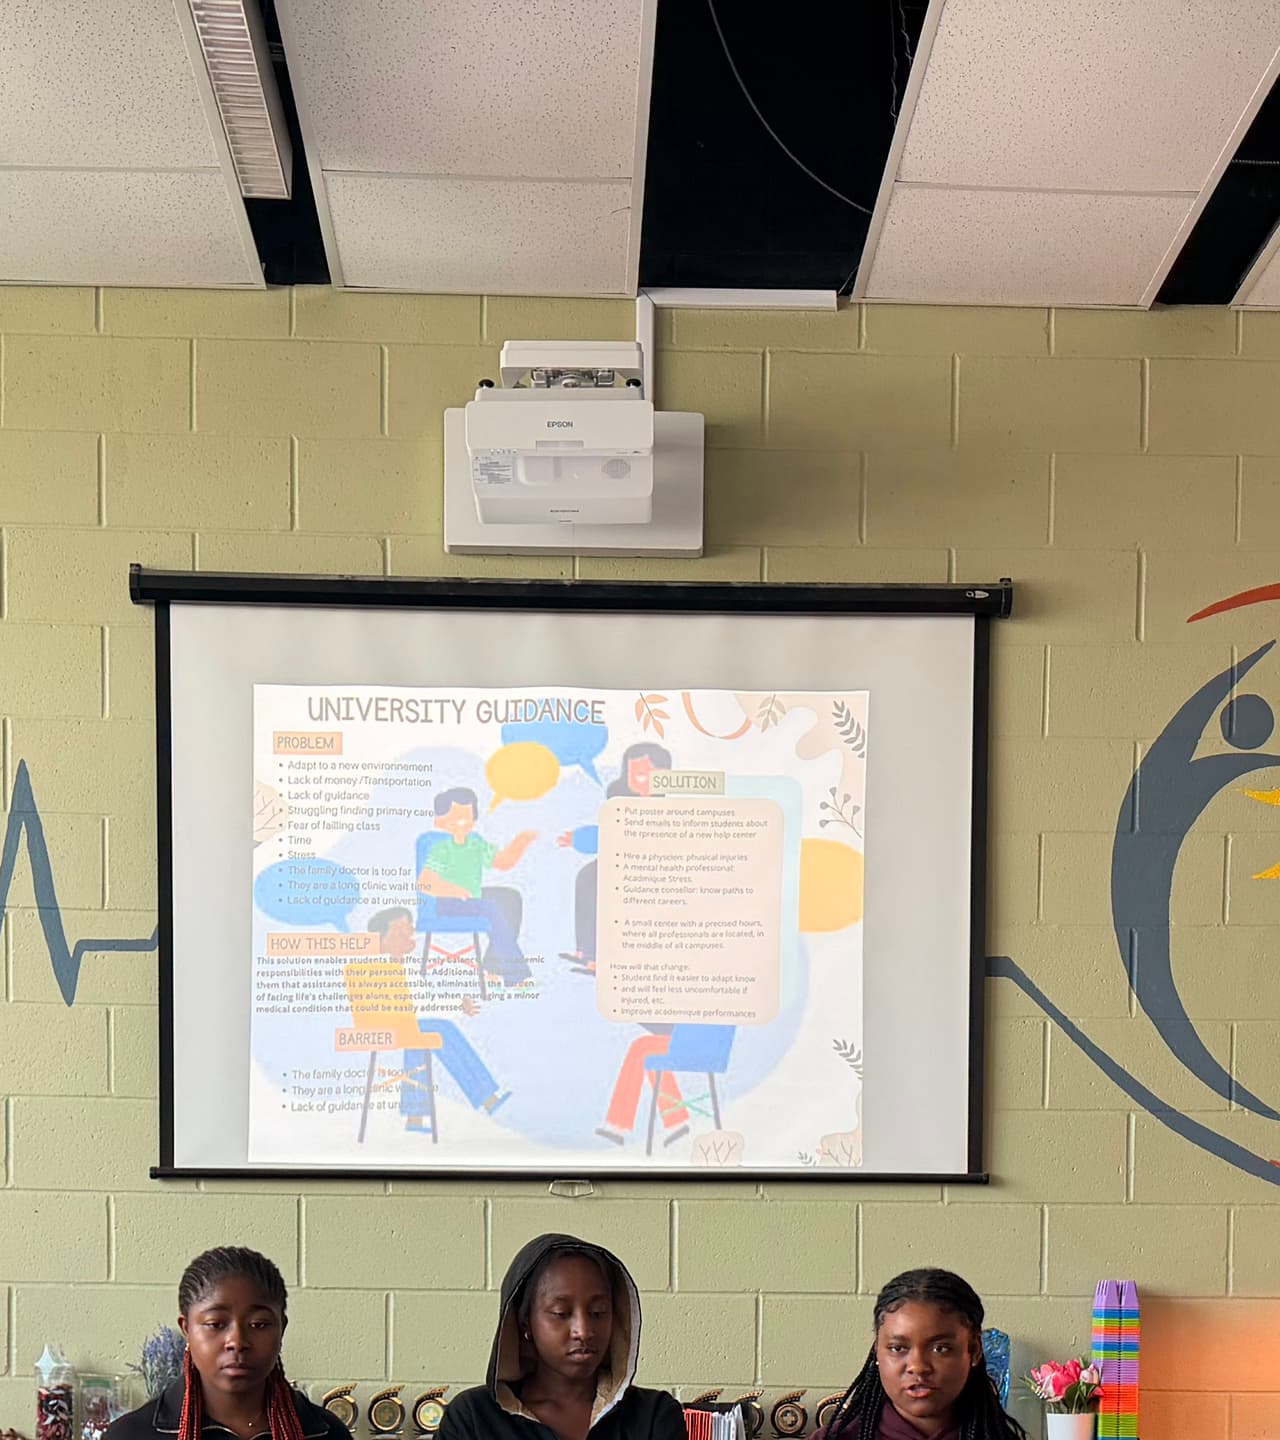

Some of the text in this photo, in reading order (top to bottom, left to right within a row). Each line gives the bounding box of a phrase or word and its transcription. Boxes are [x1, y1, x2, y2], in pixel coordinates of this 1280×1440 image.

[546, 420, 574, 429] EPSON
[308, 697, 606, 725] UNIVERSITY GUIDANCE
[277, 736, 334, 750] PROBLEM
[288, 761, 316, 772] Adapt
[318, 761, 329, 771] to
[330, 763, 336, 771] a
[338, 763, 359, 771] new
[288, 775, 311, 785] Lack
[313, 775, 322, 785] of
[324, 778, 360, 787] money
[653, 776, 717, 789] SOLUTION
[288, 791, 370, 802] Lack of guidance
[288, 805, 338, 817] Struggling
[340, 805, 374, 817] finding
[376, 806, 412, 817] primary
[624, 807, 735, 817] Put poster around campuses
[288, 821, 308, 830] Fear
[310, 821, 320, 830] of
[355, 822, 381, 831] class
[646, 819, 671, 827] emails
[682, 819, 709, 827] inform
[711, 820, 744, 828] students
[288, 835, 312, 845] Time
[714, 831, 730, 839] help
[288, 850, 316, 860] Stress
[288, 865, 412, 877] The family doctor is too far
[288, 881, 311, 892] They
[313, 883, 329, 891] are
[330, 883, 337, 891] a
[338, 881, 360, 892] long
[362, 881, 387, 891] clinic
[389, 882, 408, 891] wait
[288, 896, 311, 905] Lack
[313, 896, 321, 905] of
[323, 896, 370, 906] guidance
[371, 897, 381, 905] at
[271, 938, 371, 950] HOW THIS HELP
[256, 956, 274, 965] This
[276, 956, 312, 965] solution
[314, 956, 347, 964] enables
[349, 956, 387, 964] students
[256, 968, 324, 978] responsibilities
[327, 968, 344, 977] with
[346, 968, 367, 976] their
[369, 967, 407, 978] personal
[256, 980, 280, 989] them
[282, 979, 300, 988] that
[302, 979, 347, 988] assistance
[349, 980, 356, 988] is
[358, 980, 388, 990] always
[390, 979, 435, 989] accessible,
[256, 992, 265, 1001] of
[267, 992, 294, 1002] facing
[296, 991, 315, 1001] life's
[318, 991, 363, 1002] challenges
[365, 992, 391, 1002] alone,
[393, 991, 436, 1002] especially
[438, 991, 461, 1000] when
[514, 991, 540, 1000] minor
[256, 1004, 290, 1013] medical
[293, 1004, 333, 1013] condition
[335, 1003, 353, 1012] that
[356, 1003, 379, 1012] could
[382, 1003, 391, 1012] be
[393, 1003, 419, 1014] easily
[339, 1033, 393, 1045] BARRIER
